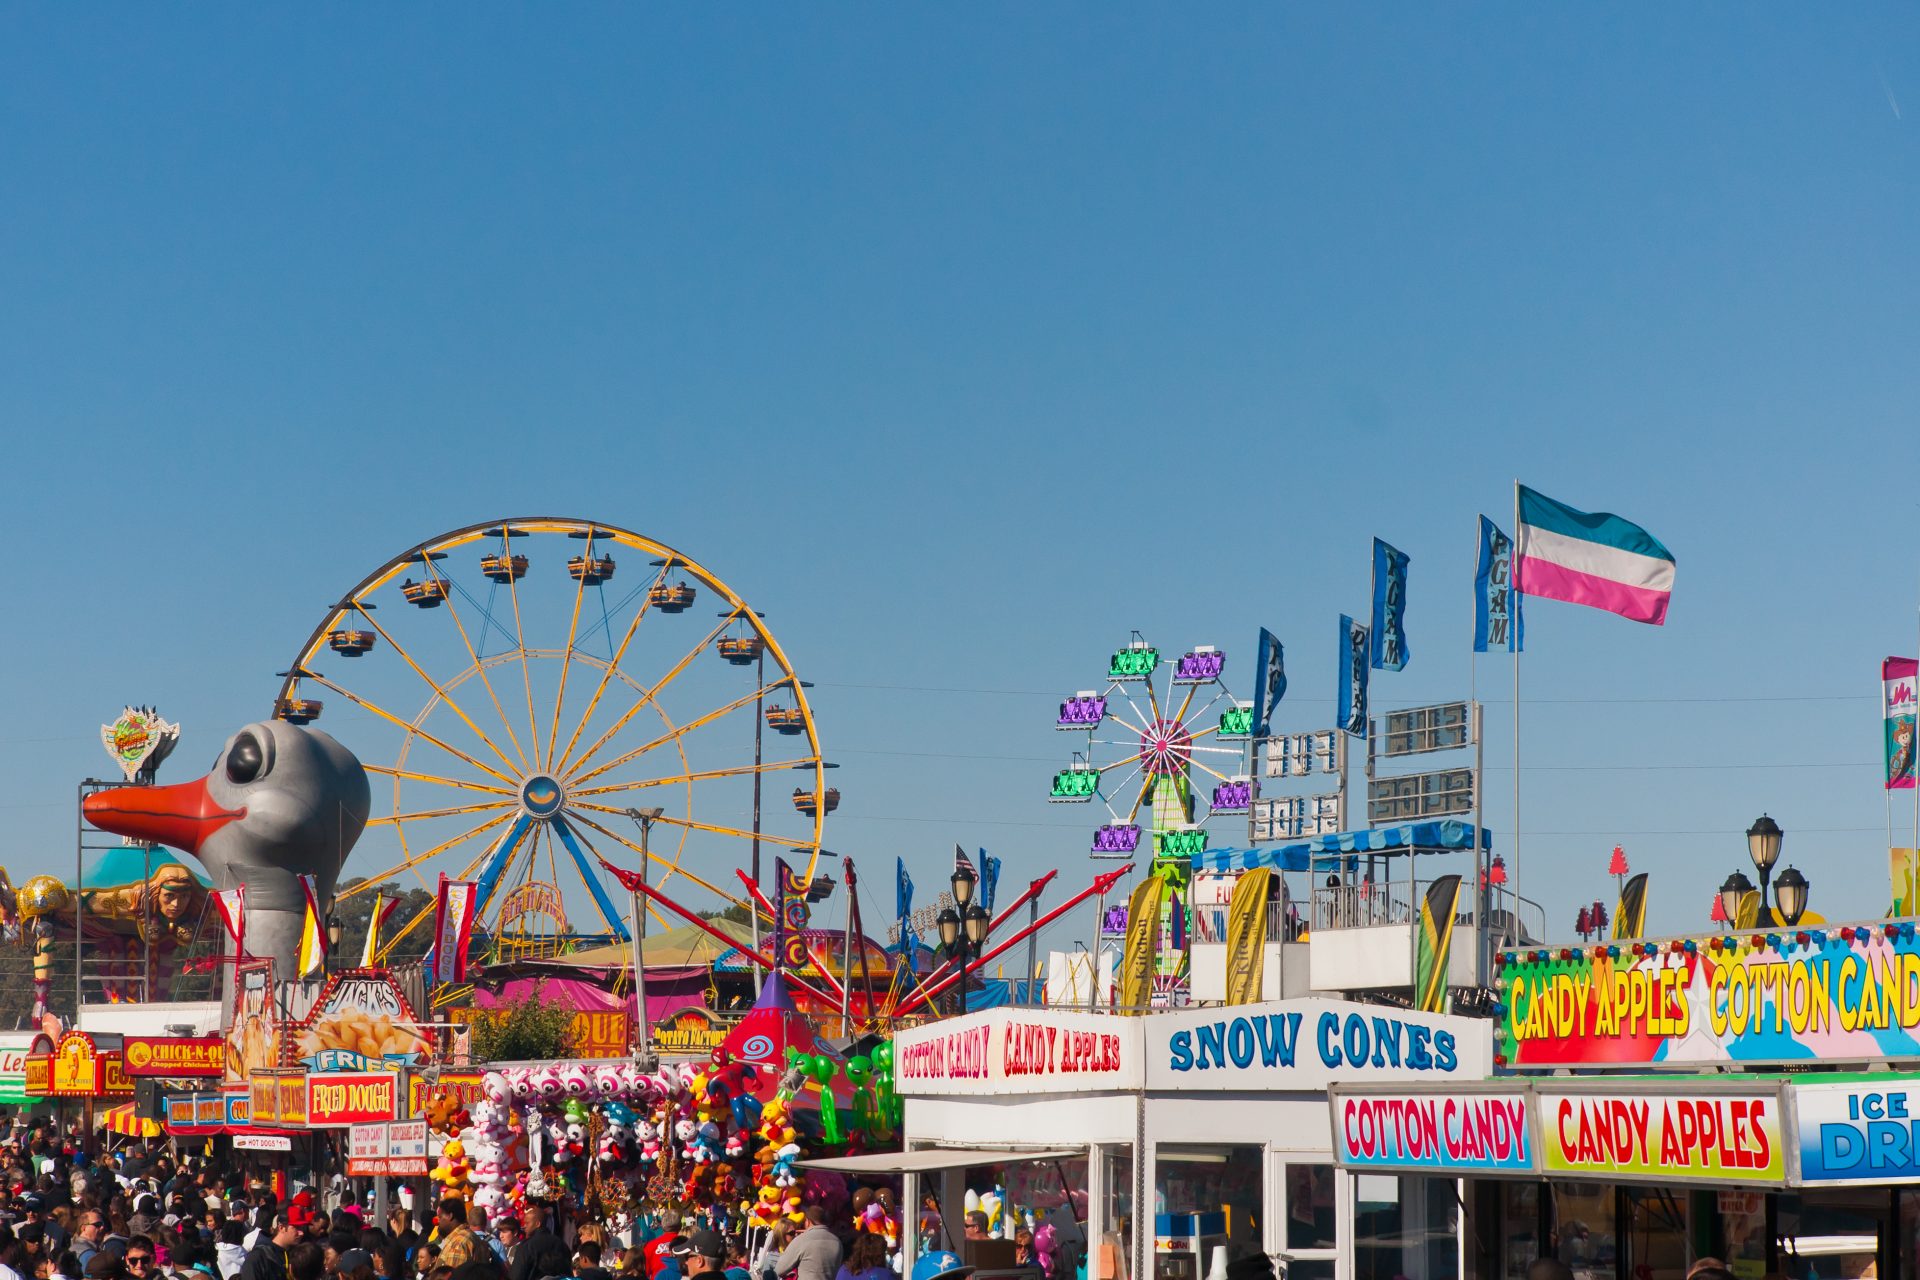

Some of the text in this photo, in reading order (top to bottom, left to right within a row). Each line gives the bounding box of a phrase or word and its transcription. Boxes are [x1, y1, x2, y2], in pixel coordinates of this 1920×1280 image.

[1136, 919, 1147, 981] Kitchen
[1237, 912, 1250, 975] Kitchen
[325, 980, 401, 1016] JACK'S
[1511, 951, 1920, 1041] CANDY APPLES COTTON CAND
[320, 1050, 401, 1072] FRIES
[903, 1020, 1121, 1079] COTTON CANDY CANDY APPLES
[1170, 1012, 1457, 1071] SNOW CONES
[313, 1084, 347, 1118] FRIED
[349, 1082, 391, 1112] DOUGH
[1848, 1092, 1909, 1120] ICE
[1344, 1096, 1526, 1166] COTTON CANDY
[1558, 1096, 1771, 1171] CANDY APPLES
